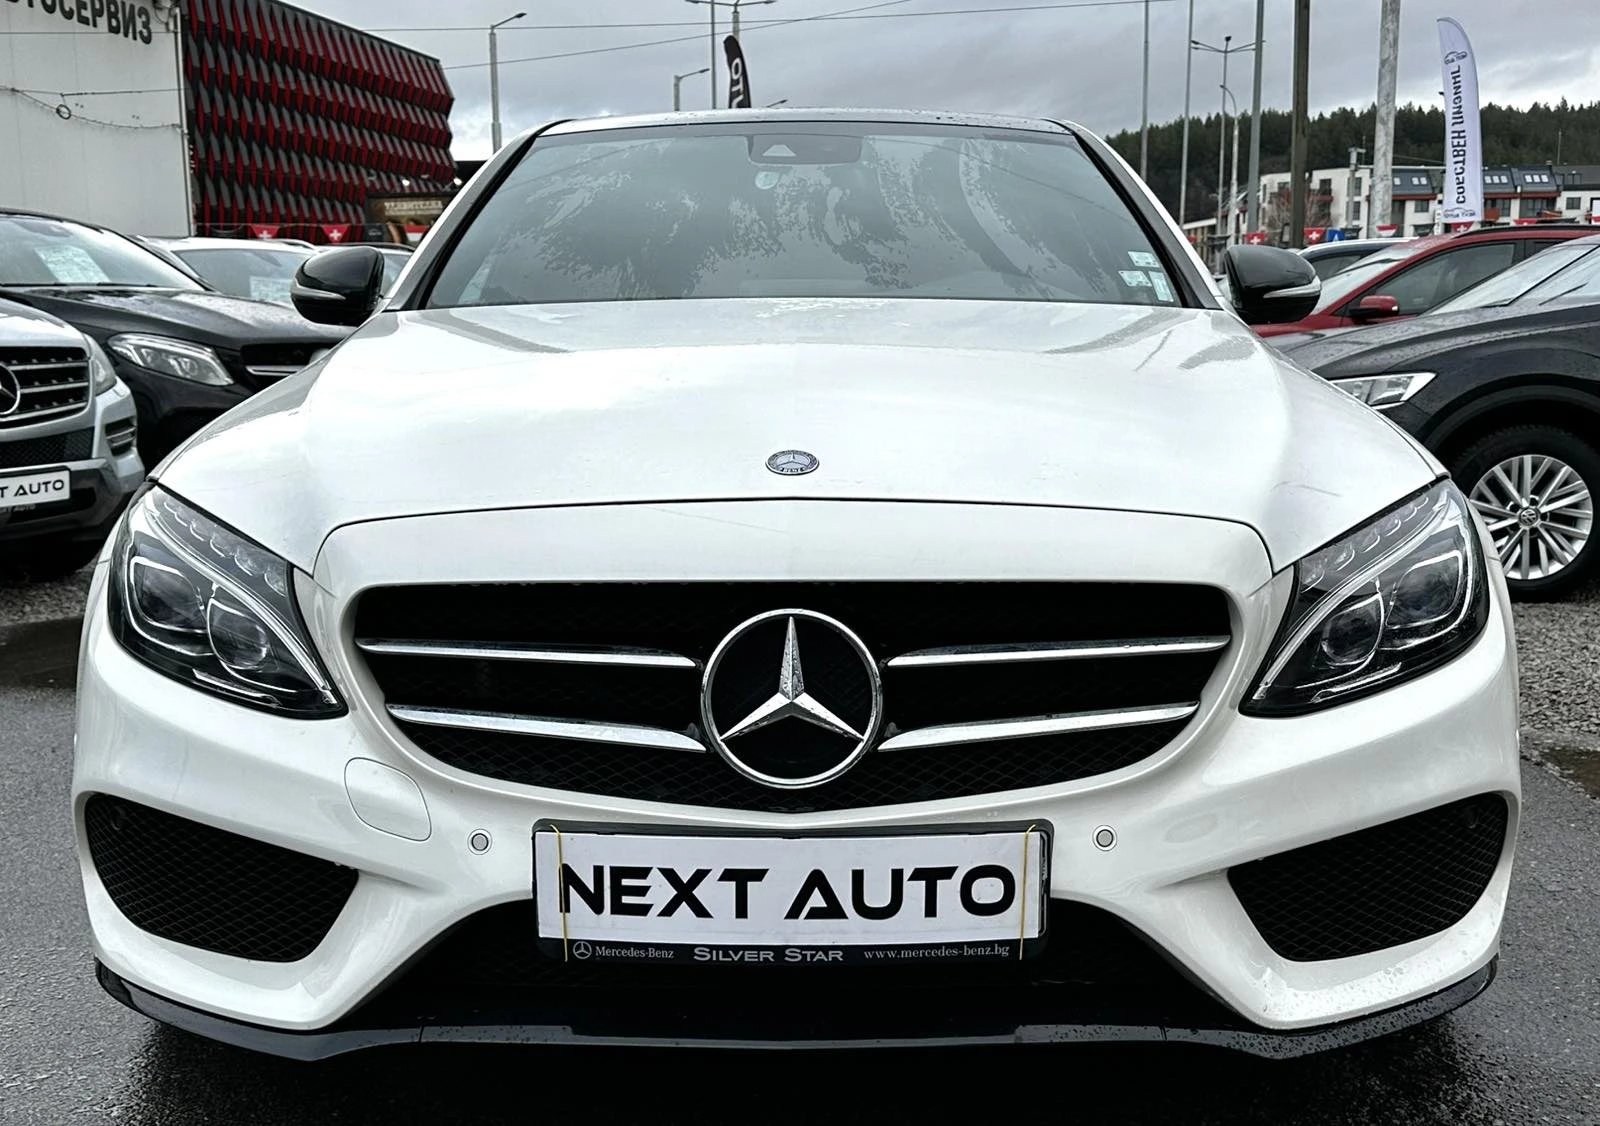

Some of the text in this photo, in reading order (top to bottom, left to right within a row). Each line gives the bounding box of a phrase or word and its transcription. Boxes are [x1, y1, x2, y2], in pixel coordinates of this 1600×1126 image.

[14, 479, 64, 497] AUTO
[558, 863, 1015, 920] NEXT AUTO
[595, 946, 674, 958] Mercedes-Benz
[864, 943, 1010, 959] www.mercedes-benz.bg
